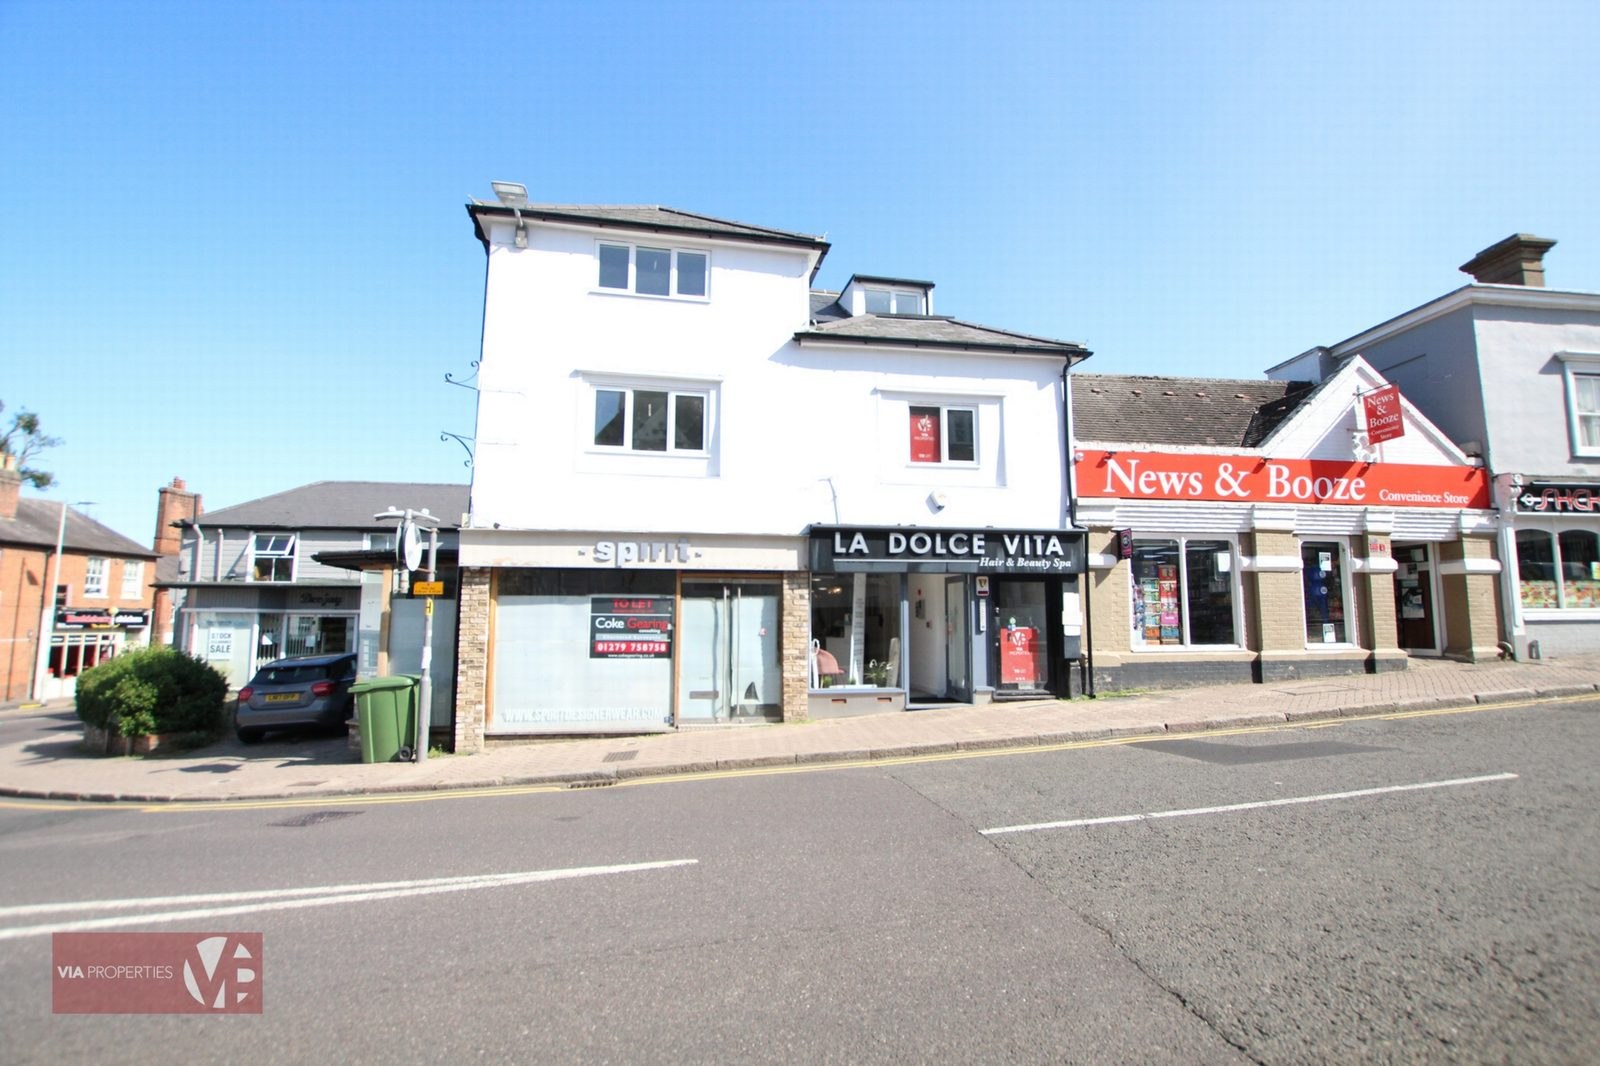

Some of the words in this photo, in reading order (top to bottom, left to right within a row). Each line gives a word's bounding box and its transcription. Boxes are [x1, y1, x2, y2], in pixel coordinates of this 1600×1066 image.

[1367, 393, 1394, 407] News
[1376, 405, 1388, 415] &
[1370, 413, 1399, 428] Booze
[1103, 458, 1202, 496] News
[1214, 462, 1251, 497] &
[1267, 464, 1366, 501] Booze
[1379, 489, 1441, 503] Convenience
[1443, 490, 1469, 504] Store
[834, 531, 869, 554] LA
[889, 532, 985, 555] DOLCE
[1003, 534, 1064, 556] VITA
[979, 557, 1004, 567] Hair
[1005, 558, 1014, 567] &
[1017, 558, 1051, 569] Beauty
[1053, 558, 1072, 570] Spa
[613, 600, 629, 608] TO
[632, 600, 653, 608] LET
[595, 617, 625, 629] Coke
[627, 617, 669, 632] Gearing
[210, 644, 231, 653] SALE
[597, 643, 626, 652] 01279
[630, 643, 666, 652] 758758
